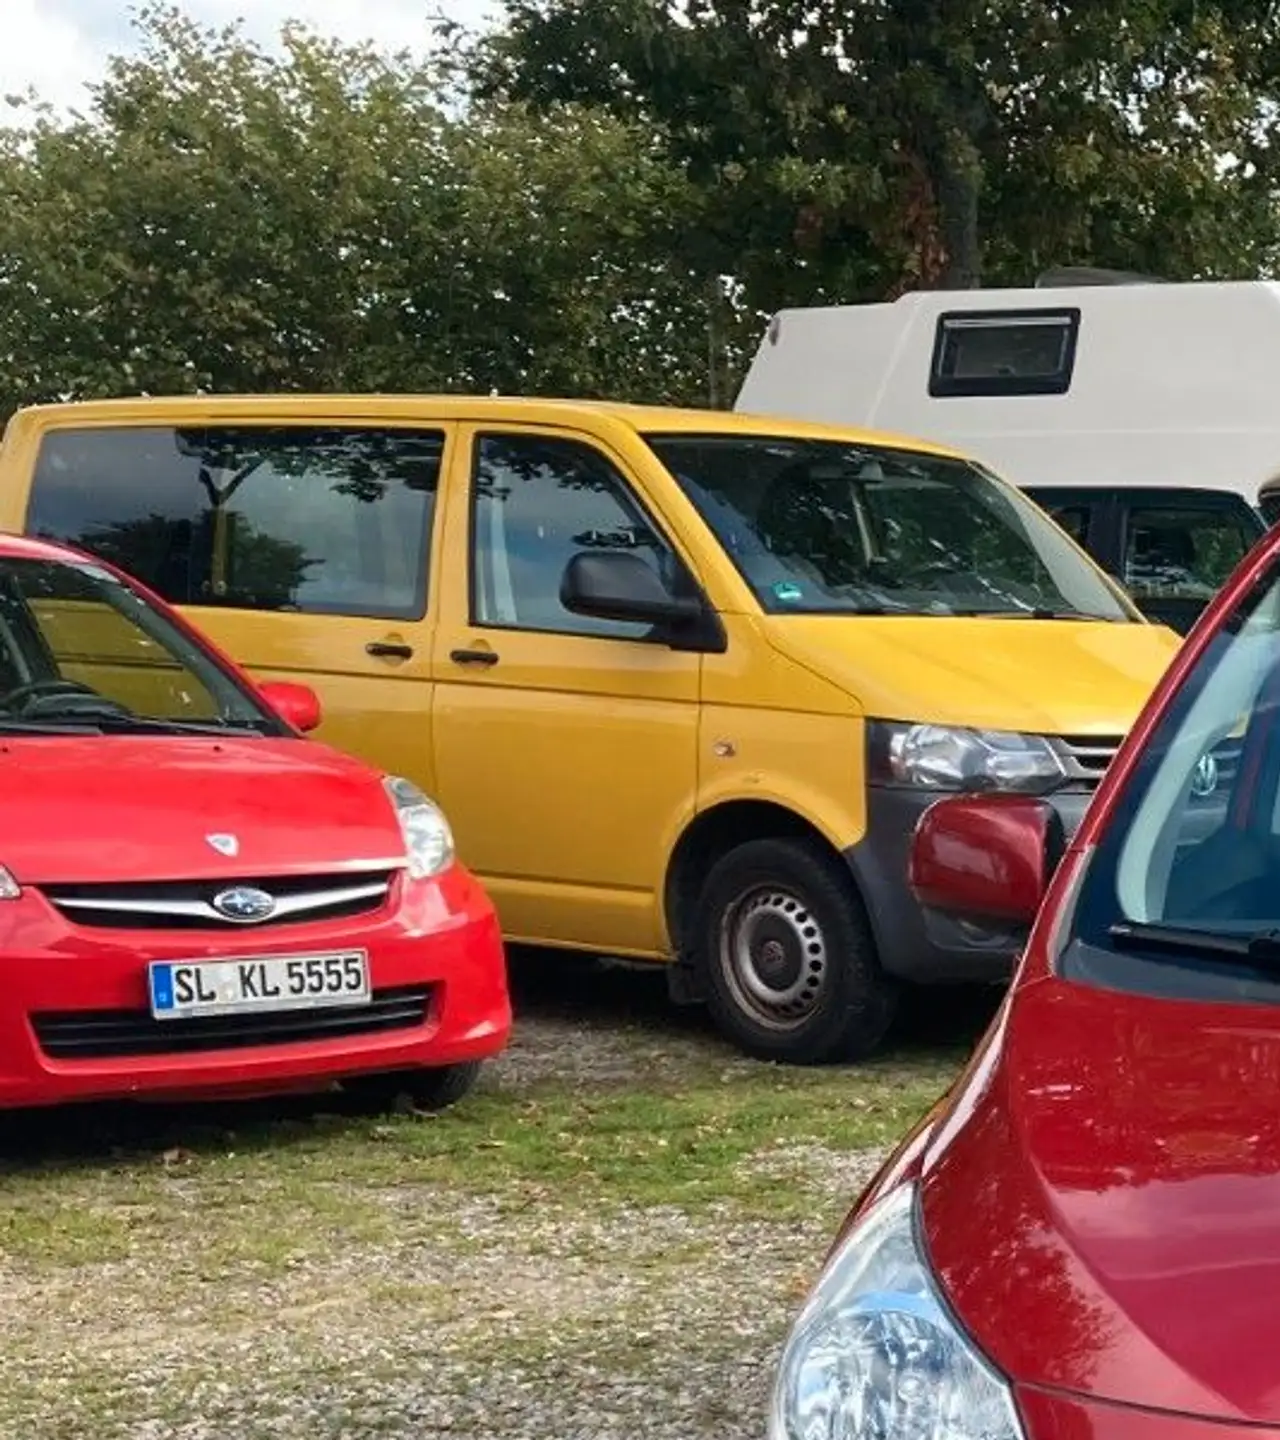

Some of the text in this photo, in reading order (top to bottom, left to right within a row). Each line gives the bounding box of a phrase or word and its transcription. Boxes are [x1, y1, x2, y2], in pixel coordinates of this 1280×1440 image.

[175, 957, 362, 1003] SL KL 5555
